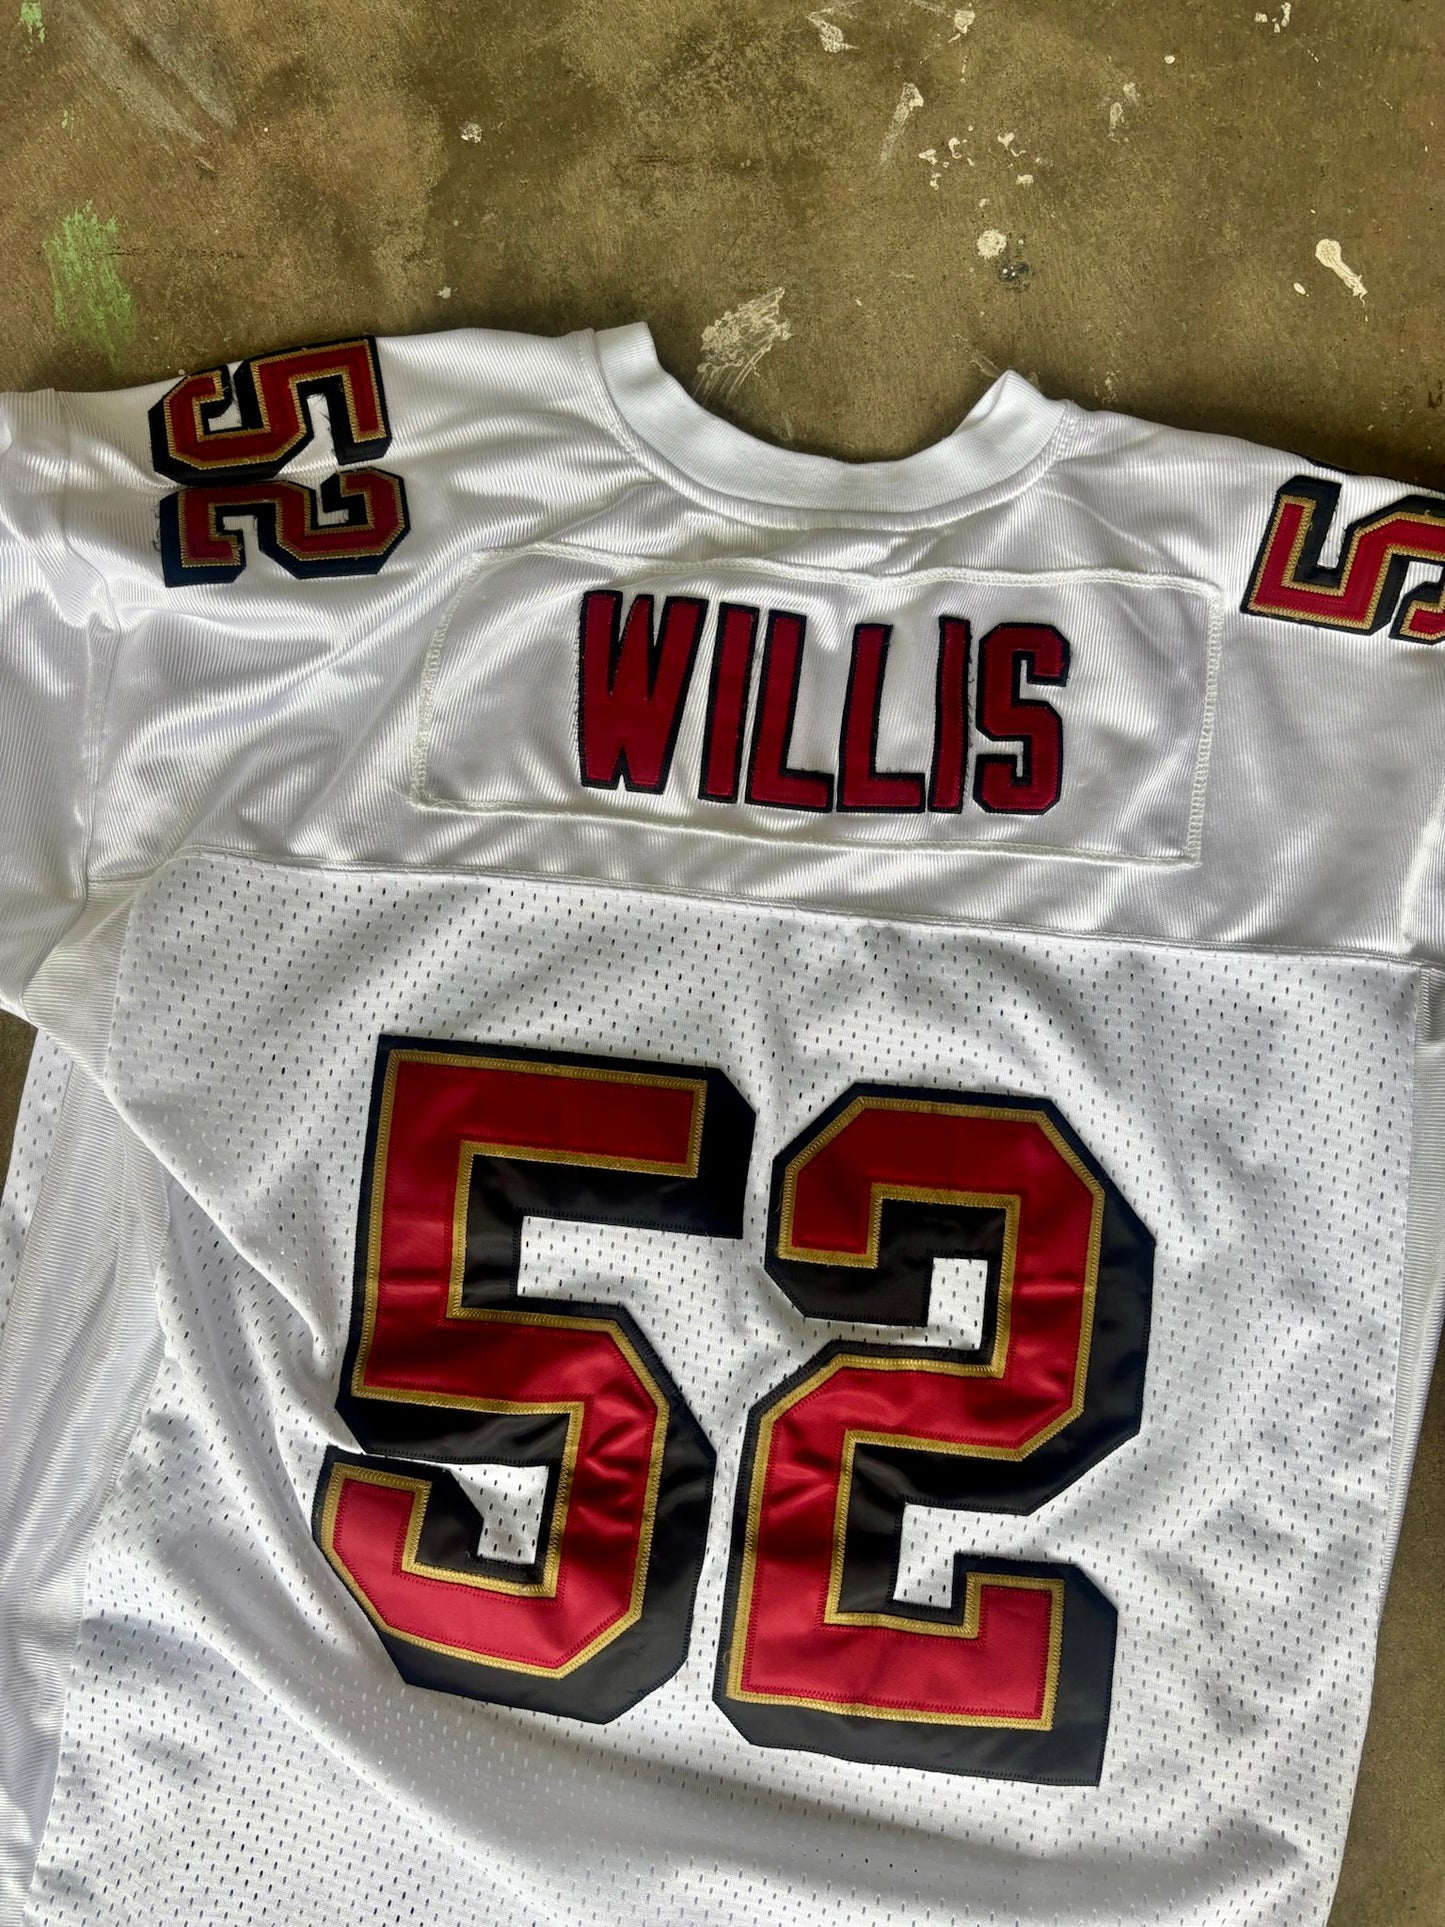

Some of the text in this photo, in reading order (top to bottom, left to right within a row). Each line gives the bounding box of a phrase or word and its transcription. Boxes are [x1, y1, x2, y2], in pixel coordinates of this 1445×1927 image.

[148, 335, 411, 587] 52
[576, 590, 1071, 815] WILLIS
[311, 1034, 1156, 1786] 52
